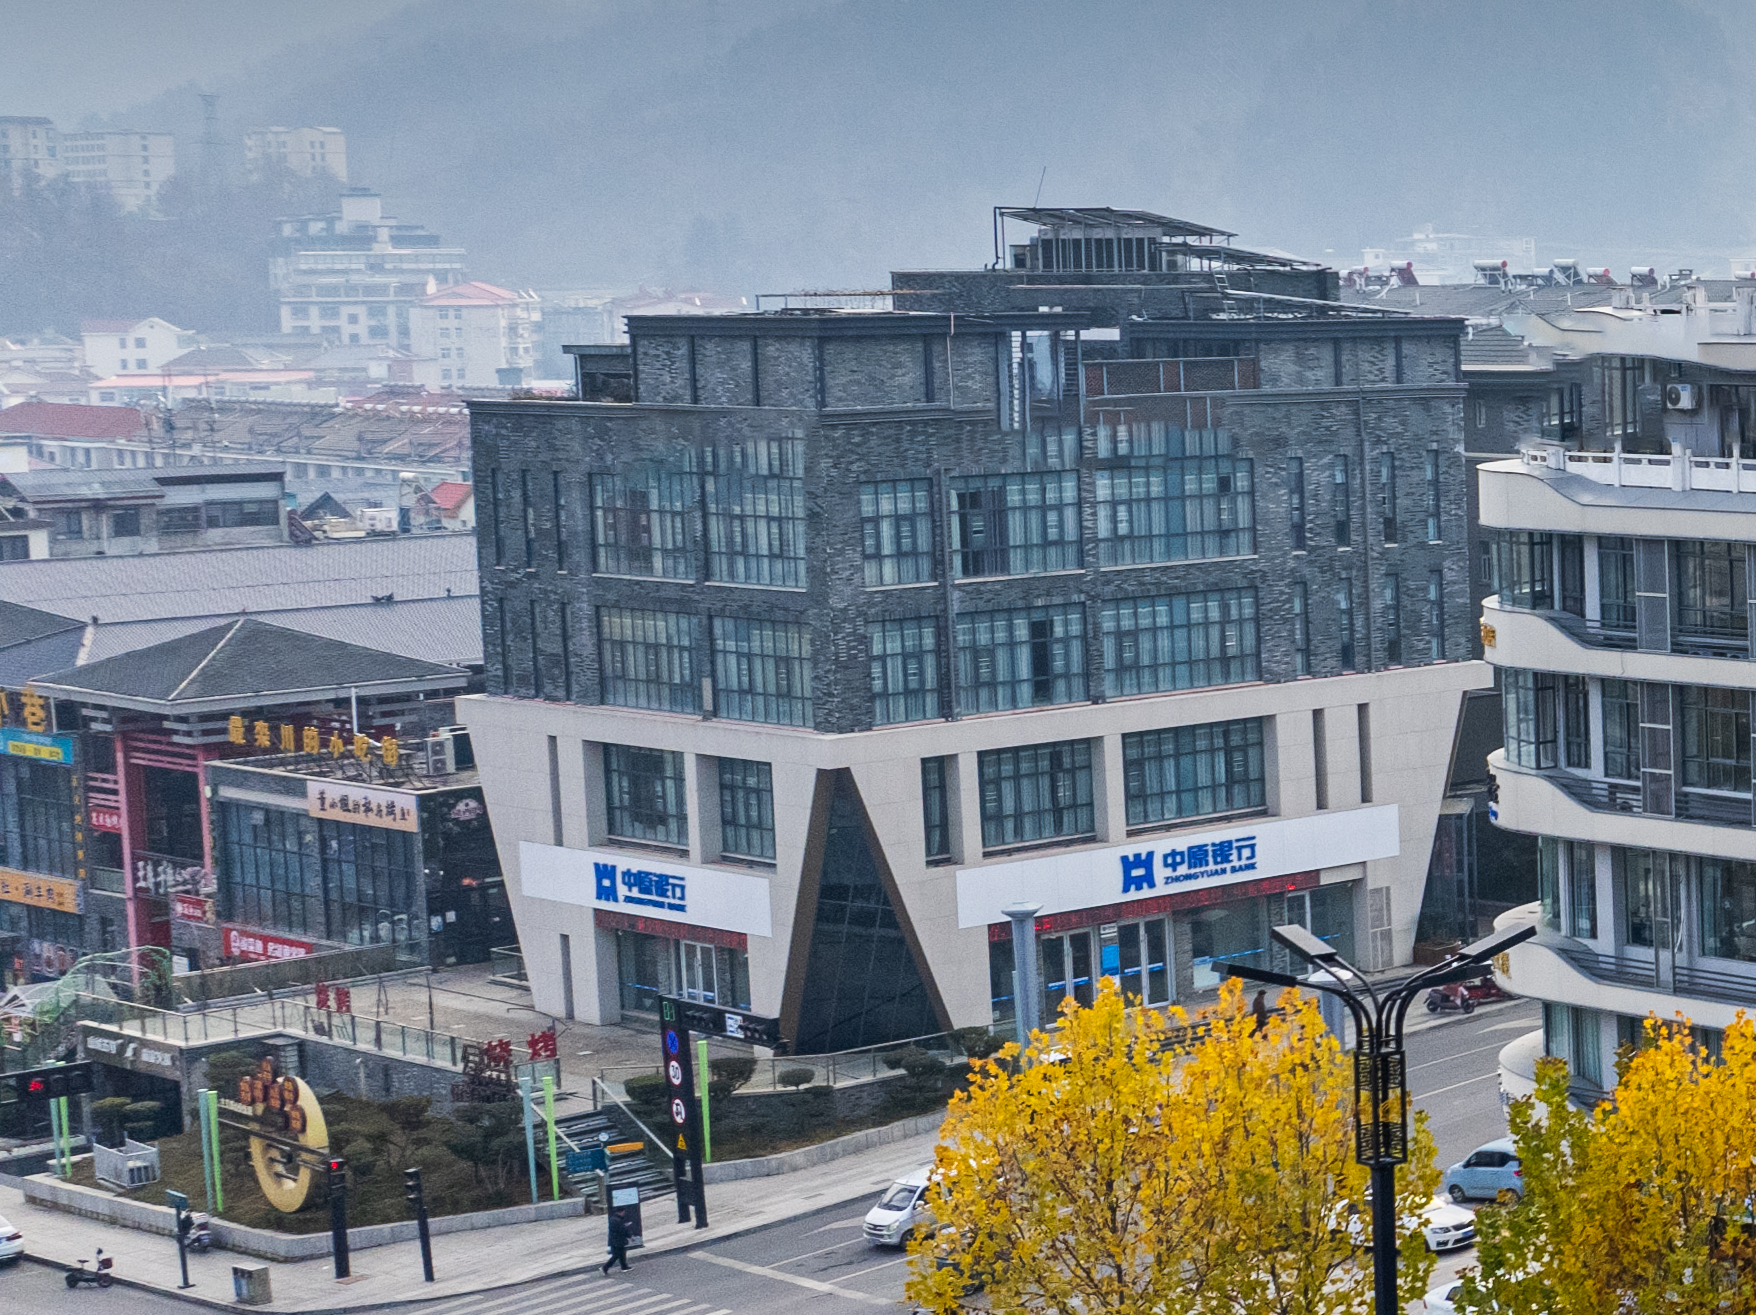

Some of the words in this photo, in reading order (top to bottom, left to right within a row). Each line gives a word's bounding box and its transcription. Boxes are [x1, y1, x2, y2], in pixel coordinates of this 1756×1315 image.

[1162, 835, 1257, 873] 中原银行
[621, 868, 687, 902] 中原银行
[1163, 866, 1228, 886] ZHONGYUAN
[1230, 861, 1258, 875] BANK
